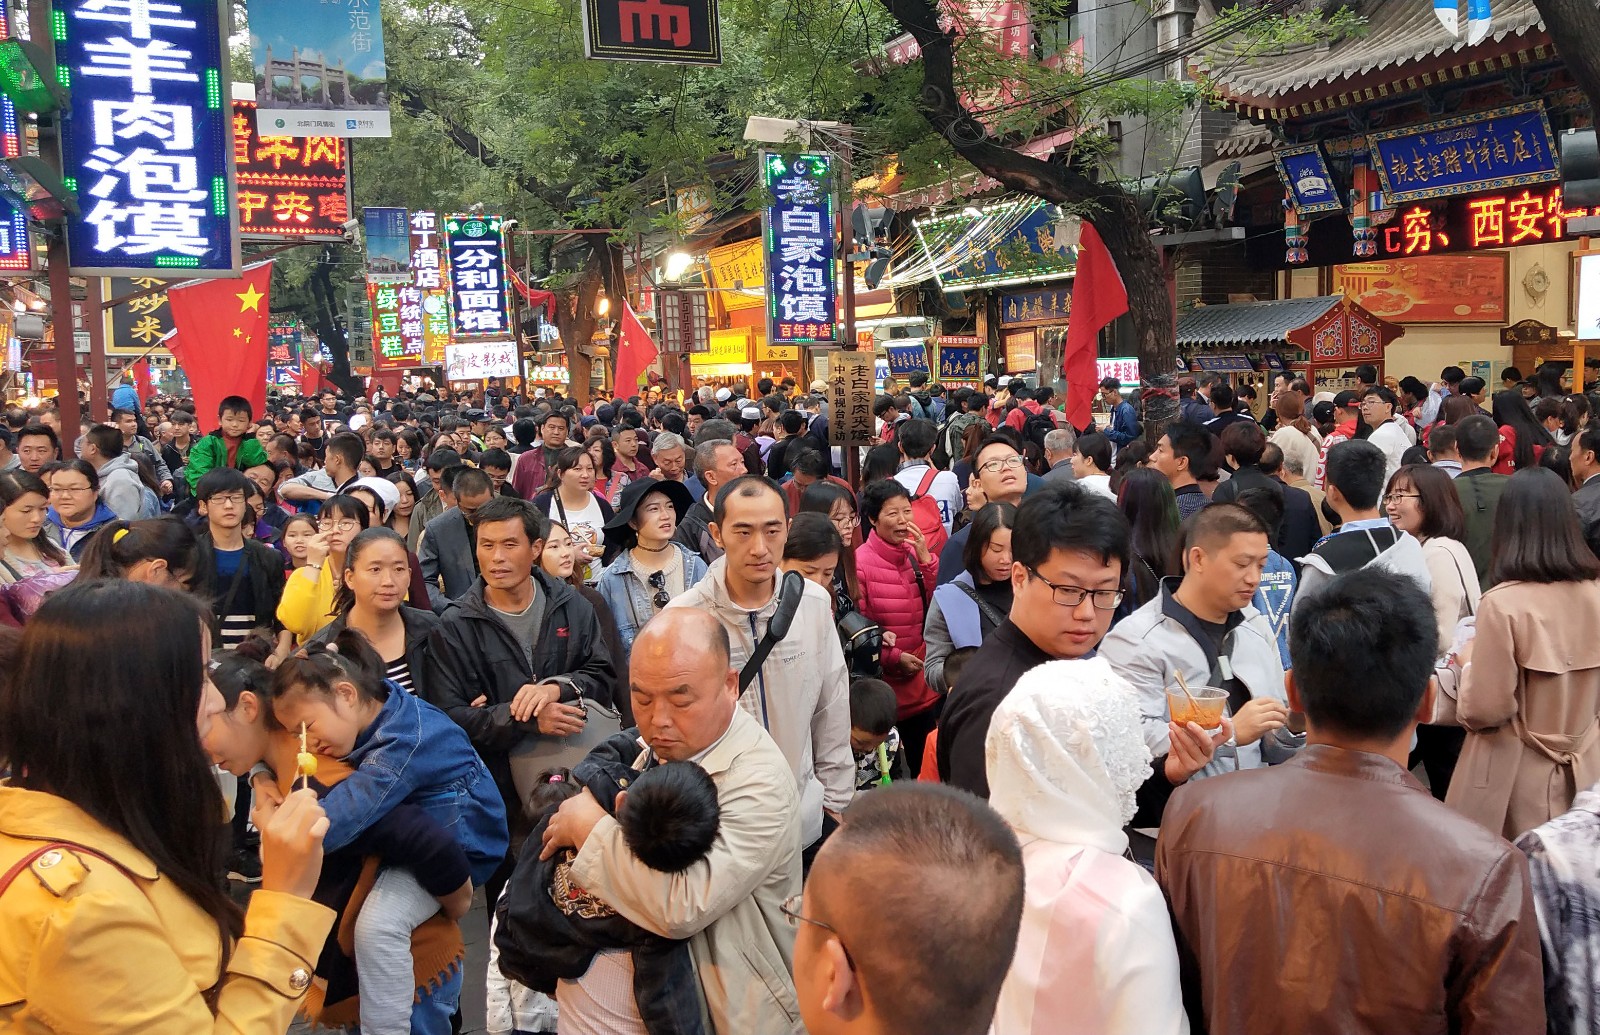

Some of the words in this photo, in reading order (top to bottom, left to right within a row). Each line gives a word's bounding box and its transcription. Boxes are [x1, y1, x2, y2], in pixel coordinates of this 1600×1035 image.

[410, 209, 441, 288] 布丁酒店
[453, 240, 501, 330] 一分利面馆
[377, 288, 403, 357] 绿豆糕
[398, 286, 422, 354] 传统糕点
[766, 349, 788, 358] 食品
[467, 351, 514, 368] 皮影戏
[834, 364, 846, 441] 中央电视台专访
